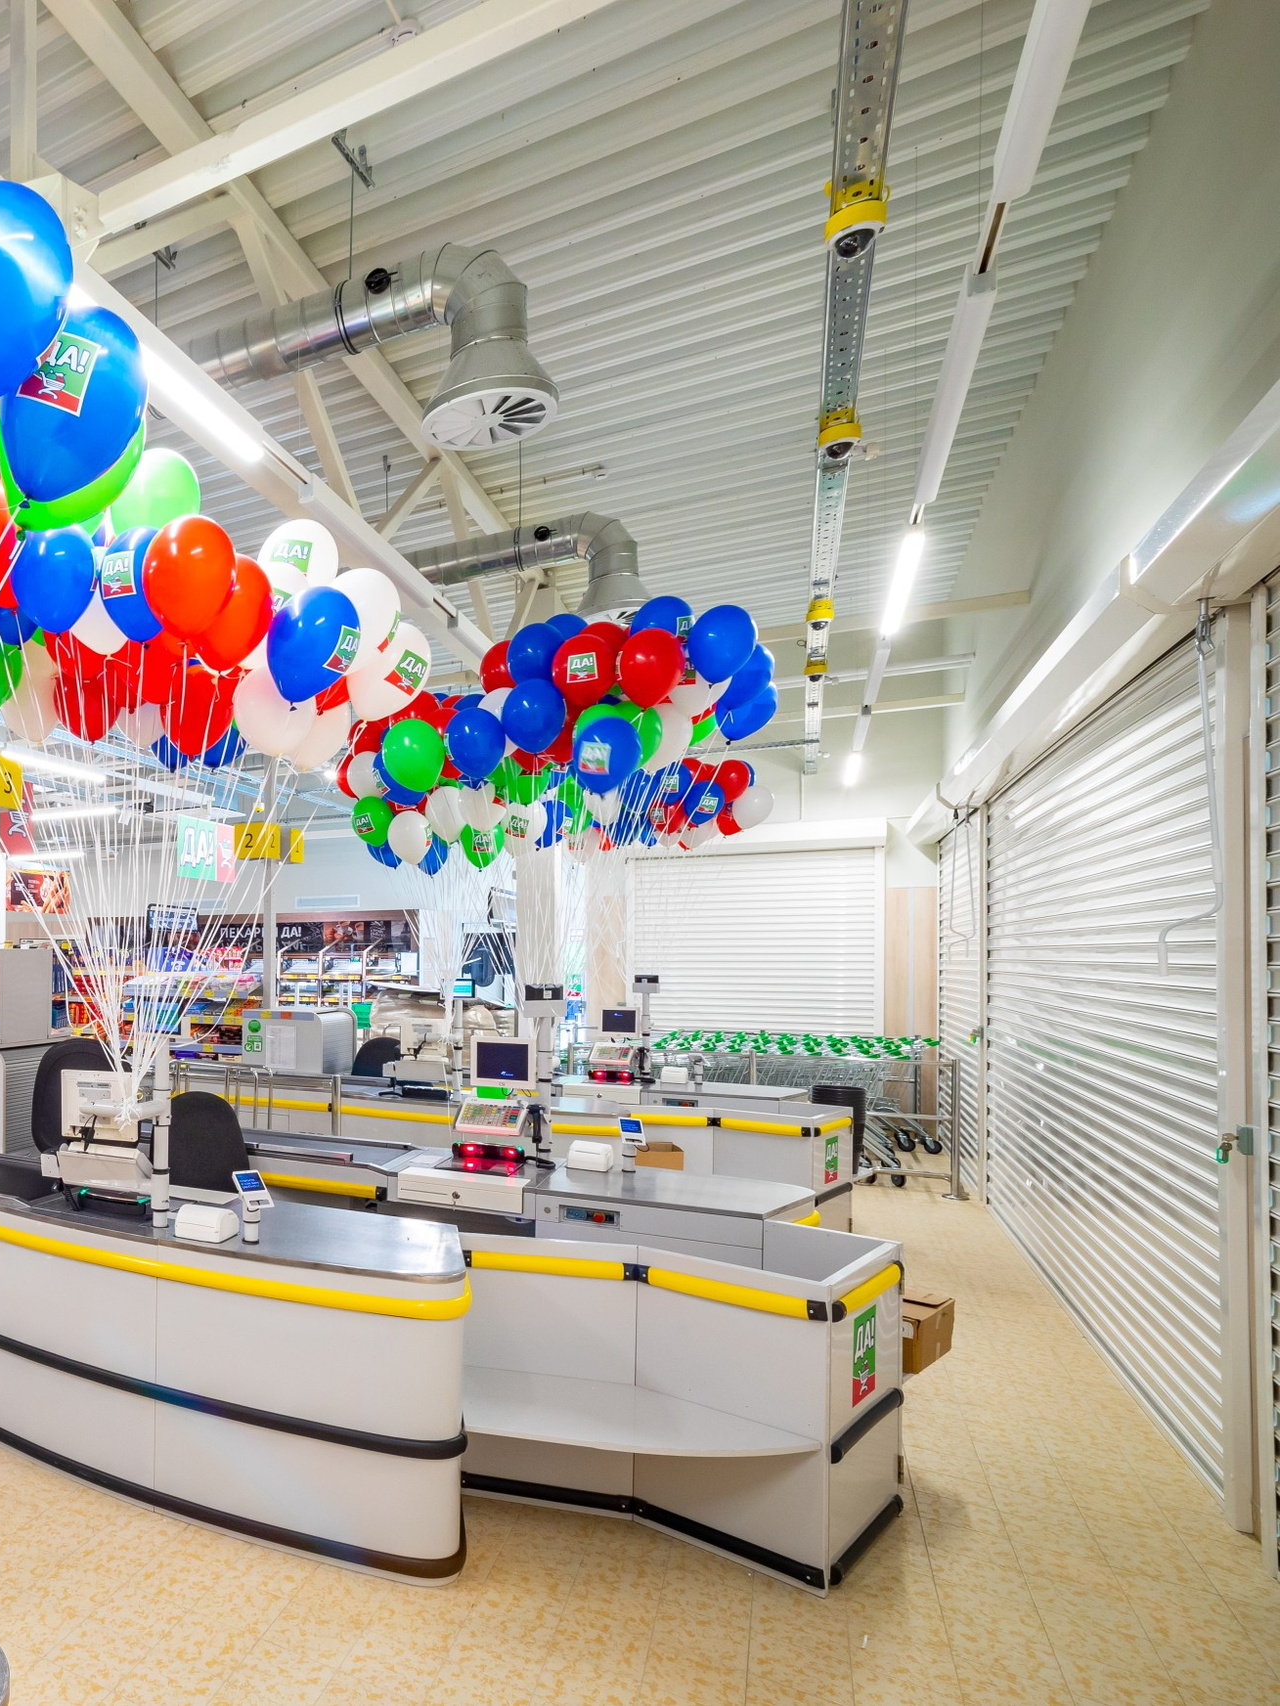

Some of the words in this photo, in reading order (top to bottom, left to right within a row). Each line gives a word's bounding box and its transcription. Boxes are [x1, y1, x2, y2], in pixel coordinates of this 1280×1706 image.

[273, 543, 309, 560] ДА!
[104, 557, 129, 577] ДА!
[399, 655, 427, 678] ДА!
[571, 657, 594, 669] ДА!
[3, 771, 13, 794] 3
[355, 815, 370, 826] ДА!
[180, 826, 214, 868] ДА!
[245, 833, 253, 848] 2
[270, 833, 275, 848] 2
[281, 926, 302, 938] ДА!
[825, 1142, 838, 1163] ДА!
[854, 1315, 876, 1365] ДА!
